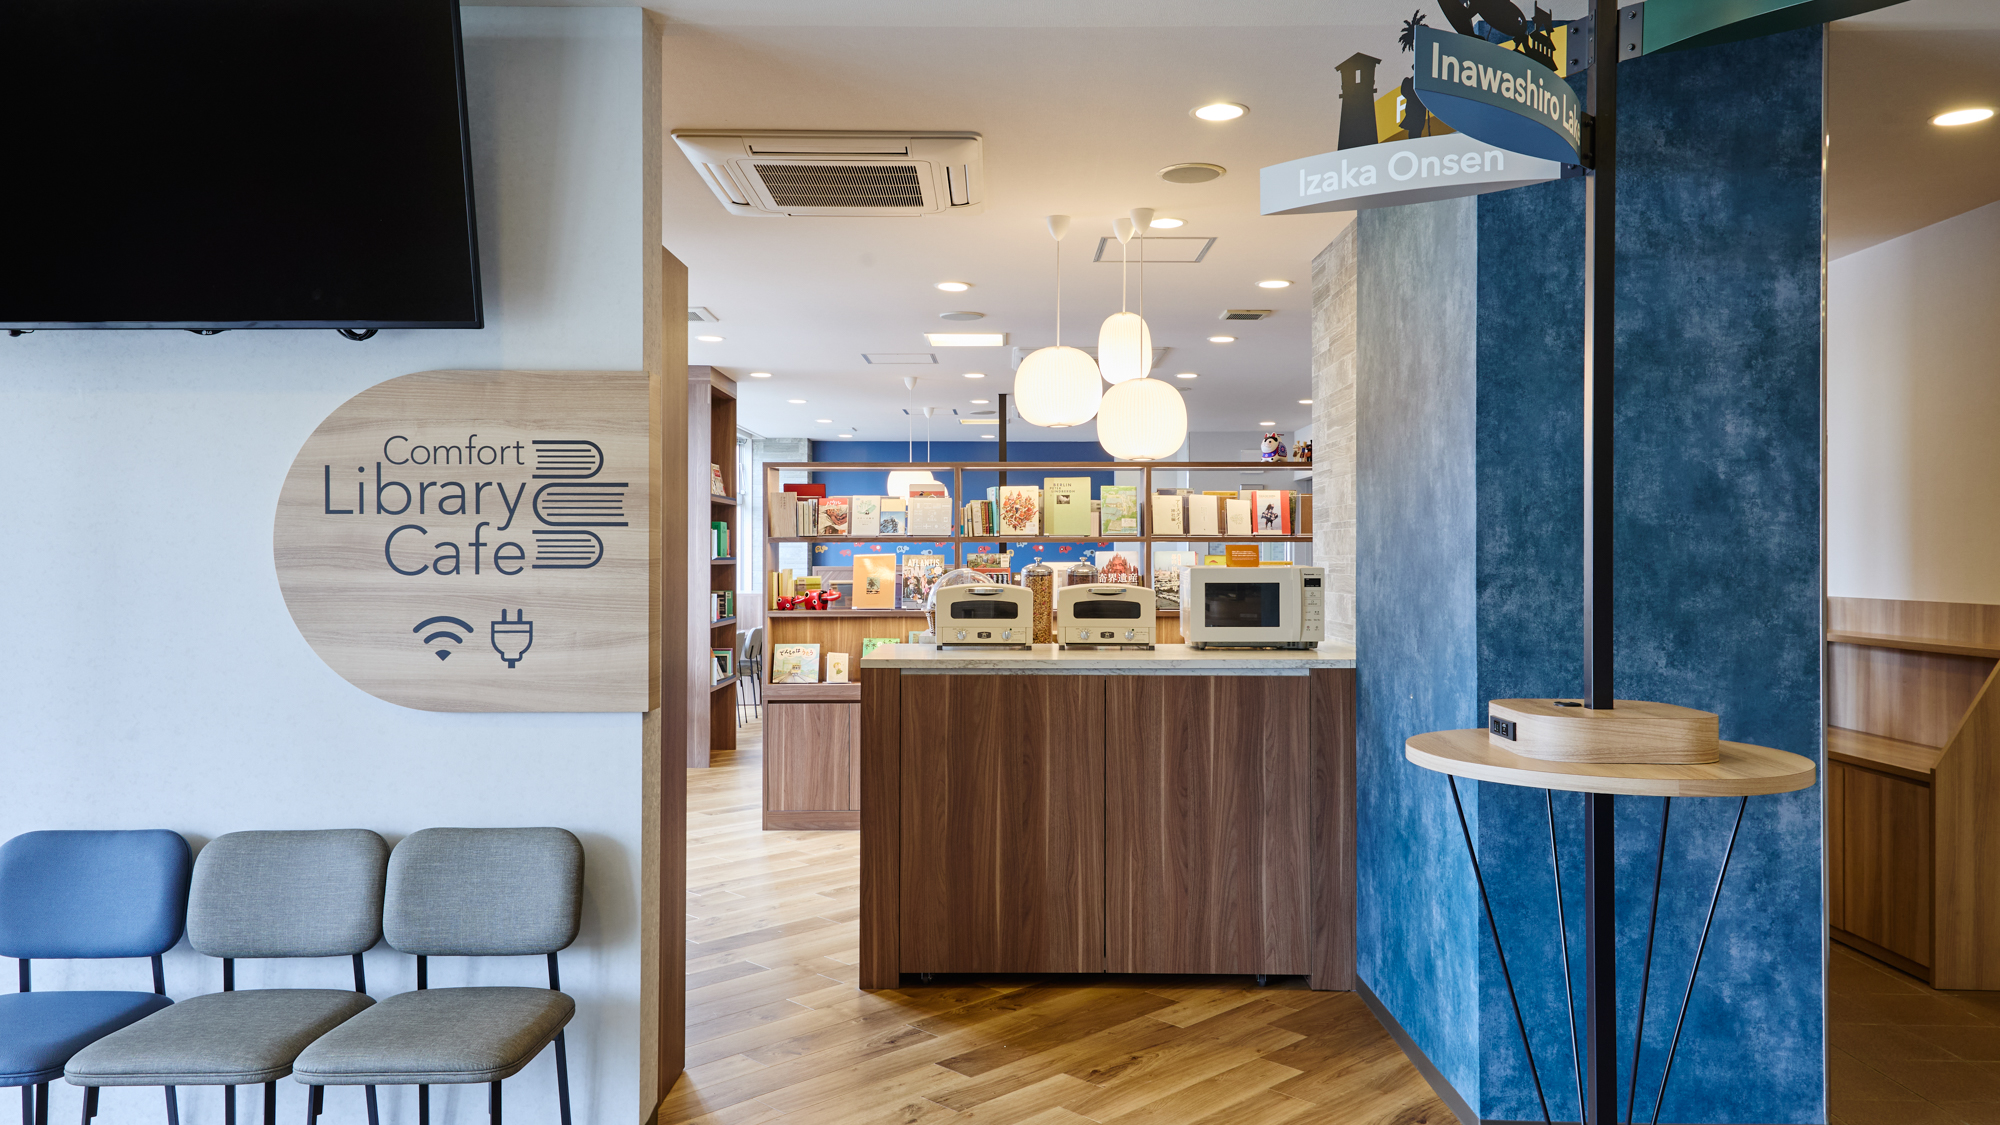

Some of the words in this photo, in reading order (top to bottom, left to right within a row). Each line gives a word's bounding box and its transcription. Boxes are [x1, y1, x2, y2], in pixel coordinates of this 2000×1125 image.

[1432, 42, 1560, 121] Inawashiro
[1299, 159, 1377, 197] Izaka
[1388, 150, 1504, 181] Onsen
[383, 434, 525, 465] Comfort
[324, 461, 527, 531] Library
[384, 521, 526, 576] Cafe
[907, 558, 940, 567] ATLANTIS
[1098, 572, 1138, 583] 奇界遺産
